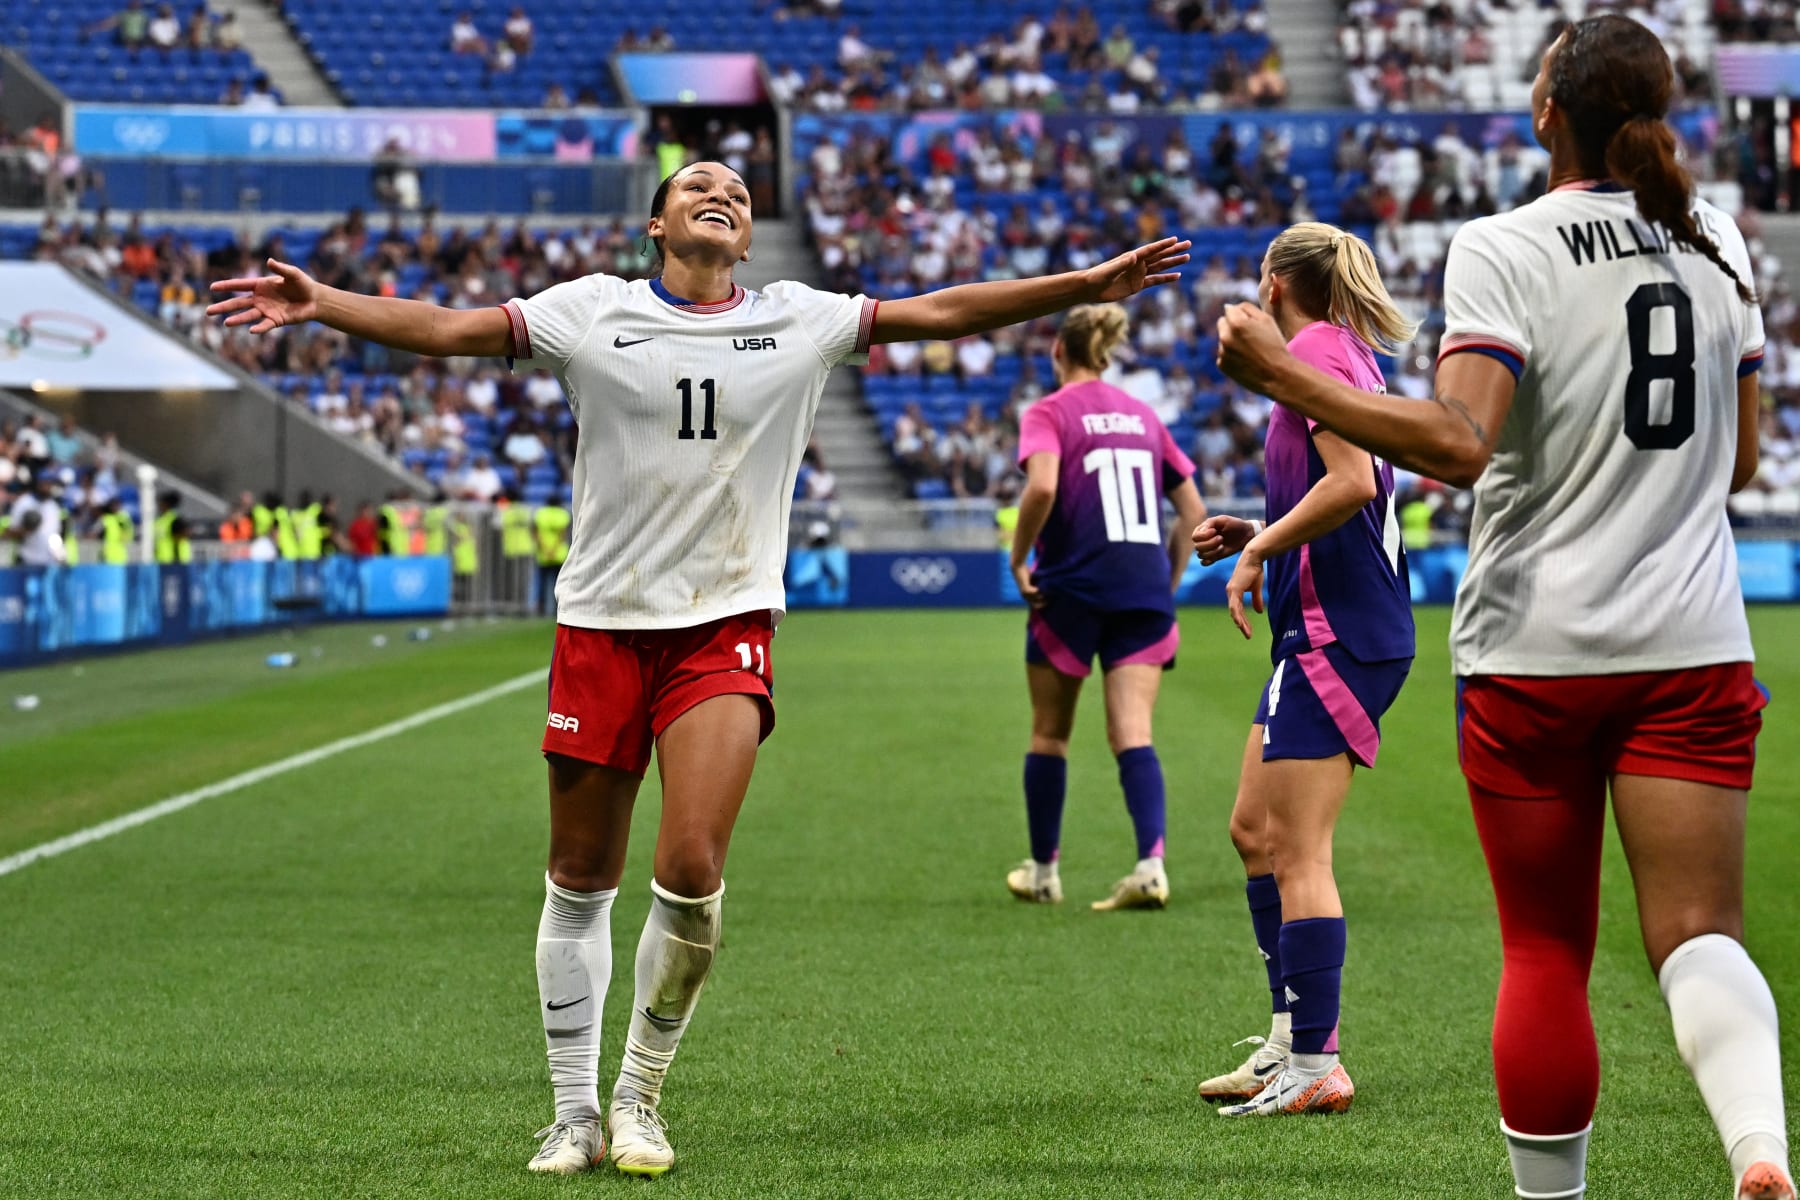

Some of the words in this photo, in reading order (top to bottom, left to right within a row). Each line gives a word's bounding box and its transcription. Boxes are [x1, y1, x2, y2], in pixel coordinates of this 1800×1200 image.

[249, 121, 352, 151] PARIS
[732, 337, 777, 351] USA
[1624, 282, 1696, 451] 8
[676, 378, 717, 440] 11
[1083, 447, 1161, 545] 10
